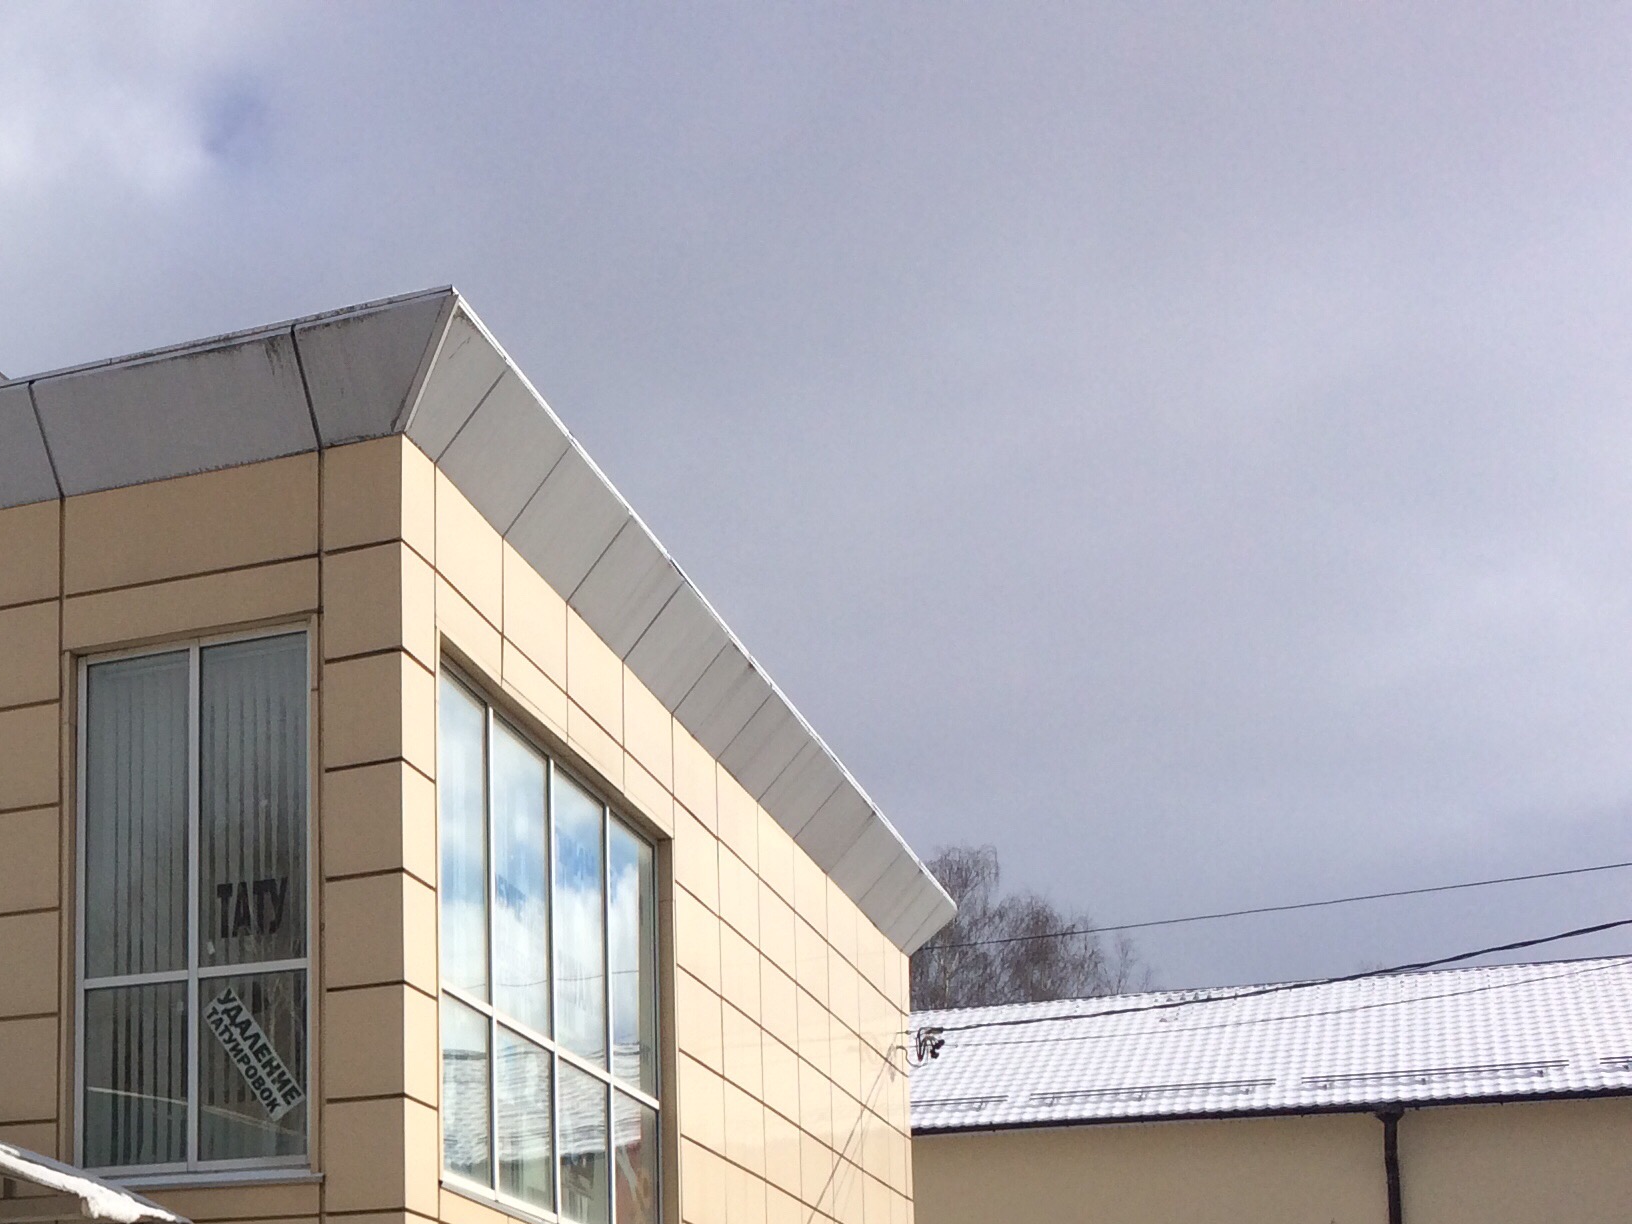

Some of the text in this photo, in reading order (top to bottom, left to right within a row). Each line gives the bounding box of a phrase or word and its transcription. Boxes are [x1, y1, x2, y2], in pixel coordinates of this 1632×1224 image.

[217, 877, 288, 938] ТАТУ
[206, 1006, 282, 1116] ТАТУИРОВОК
[216, 987, 303, 1107] УДАЛЕНИЕ
